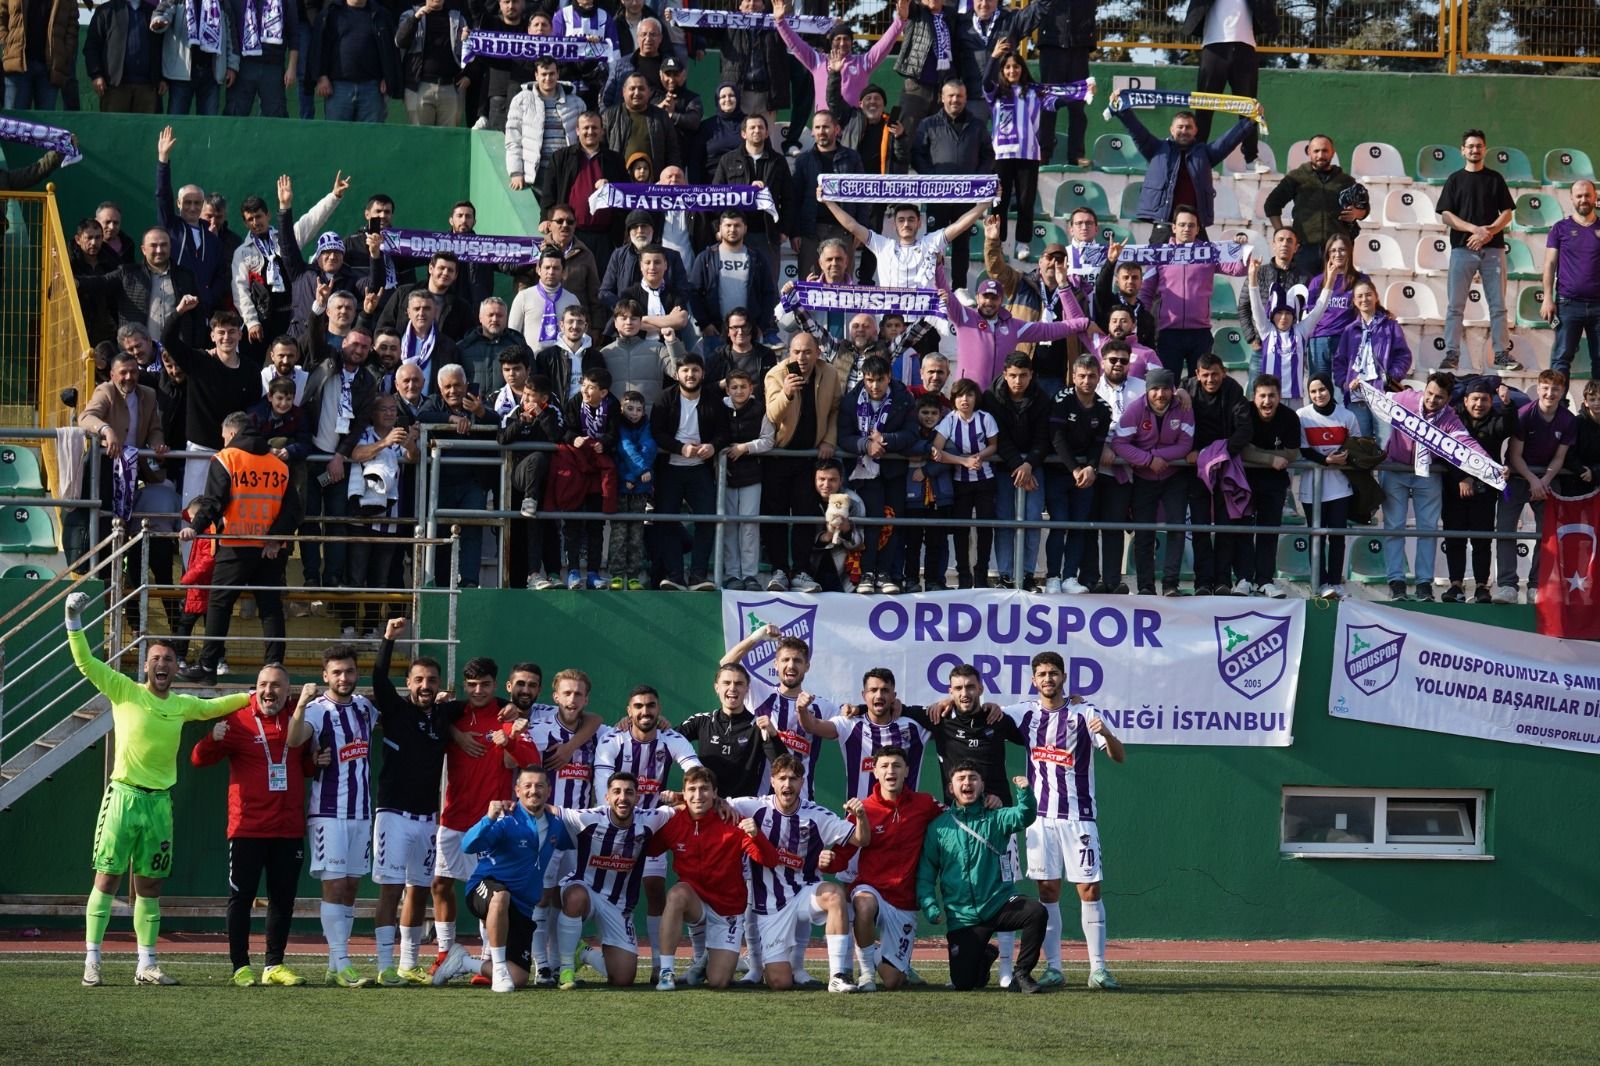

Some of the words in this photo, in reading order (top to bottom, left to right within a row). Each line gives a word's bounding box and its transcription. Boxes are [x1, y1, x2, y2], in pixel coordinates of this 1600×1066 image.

[470, 38, 580, 59] ORDUSPOR
[1128, 77, 1142, 90] D
[1128, 93, 1163, 106] FATSA
[1223, 99, 1254, 114] SPOR
[841, 180, 881, 196] SÜPER
[624, 193, 687, 210] FATSA
[697, 192, 755, 207] ORDU
[409, 236, 522, 257] ORDUSPOR
[786, 267, 797, 275] 02
[806, 289, 931, 312] ORDUSPOR
[1374, 396, 1488, 470] ORDUSPOR
[16, 511, 28, 519] 54
[868, 600, 1163, 649] ORDUSPOR
[747, 619, 810, 667] ORDUPOR
[1224, 633, 1283, 677] ORTAD
[1349, 643, 1398, 676] ORDUSPOR
[927, 652, 1104, 697] ORTD
[1418, 650, 1560, 685] ORDUSPORUMUZA
[1244, 680, 1262, 688] 2005
[1415, 677, 1488, 702] YOLUNDA
[1492, 689, 1580, 715] BAŞARILAR
[1583, 700, 1600, 718] Dİ
[1102, 704, 1164, 730] NEĞİ
[1172, 705, 1287, 732] İSTANBUL
[722, 745, 731, 755] 21
[968, 738, 979, 748] 20
[151, 853, 170, 870] 80
[1079, 849, 1095, 867] 70
